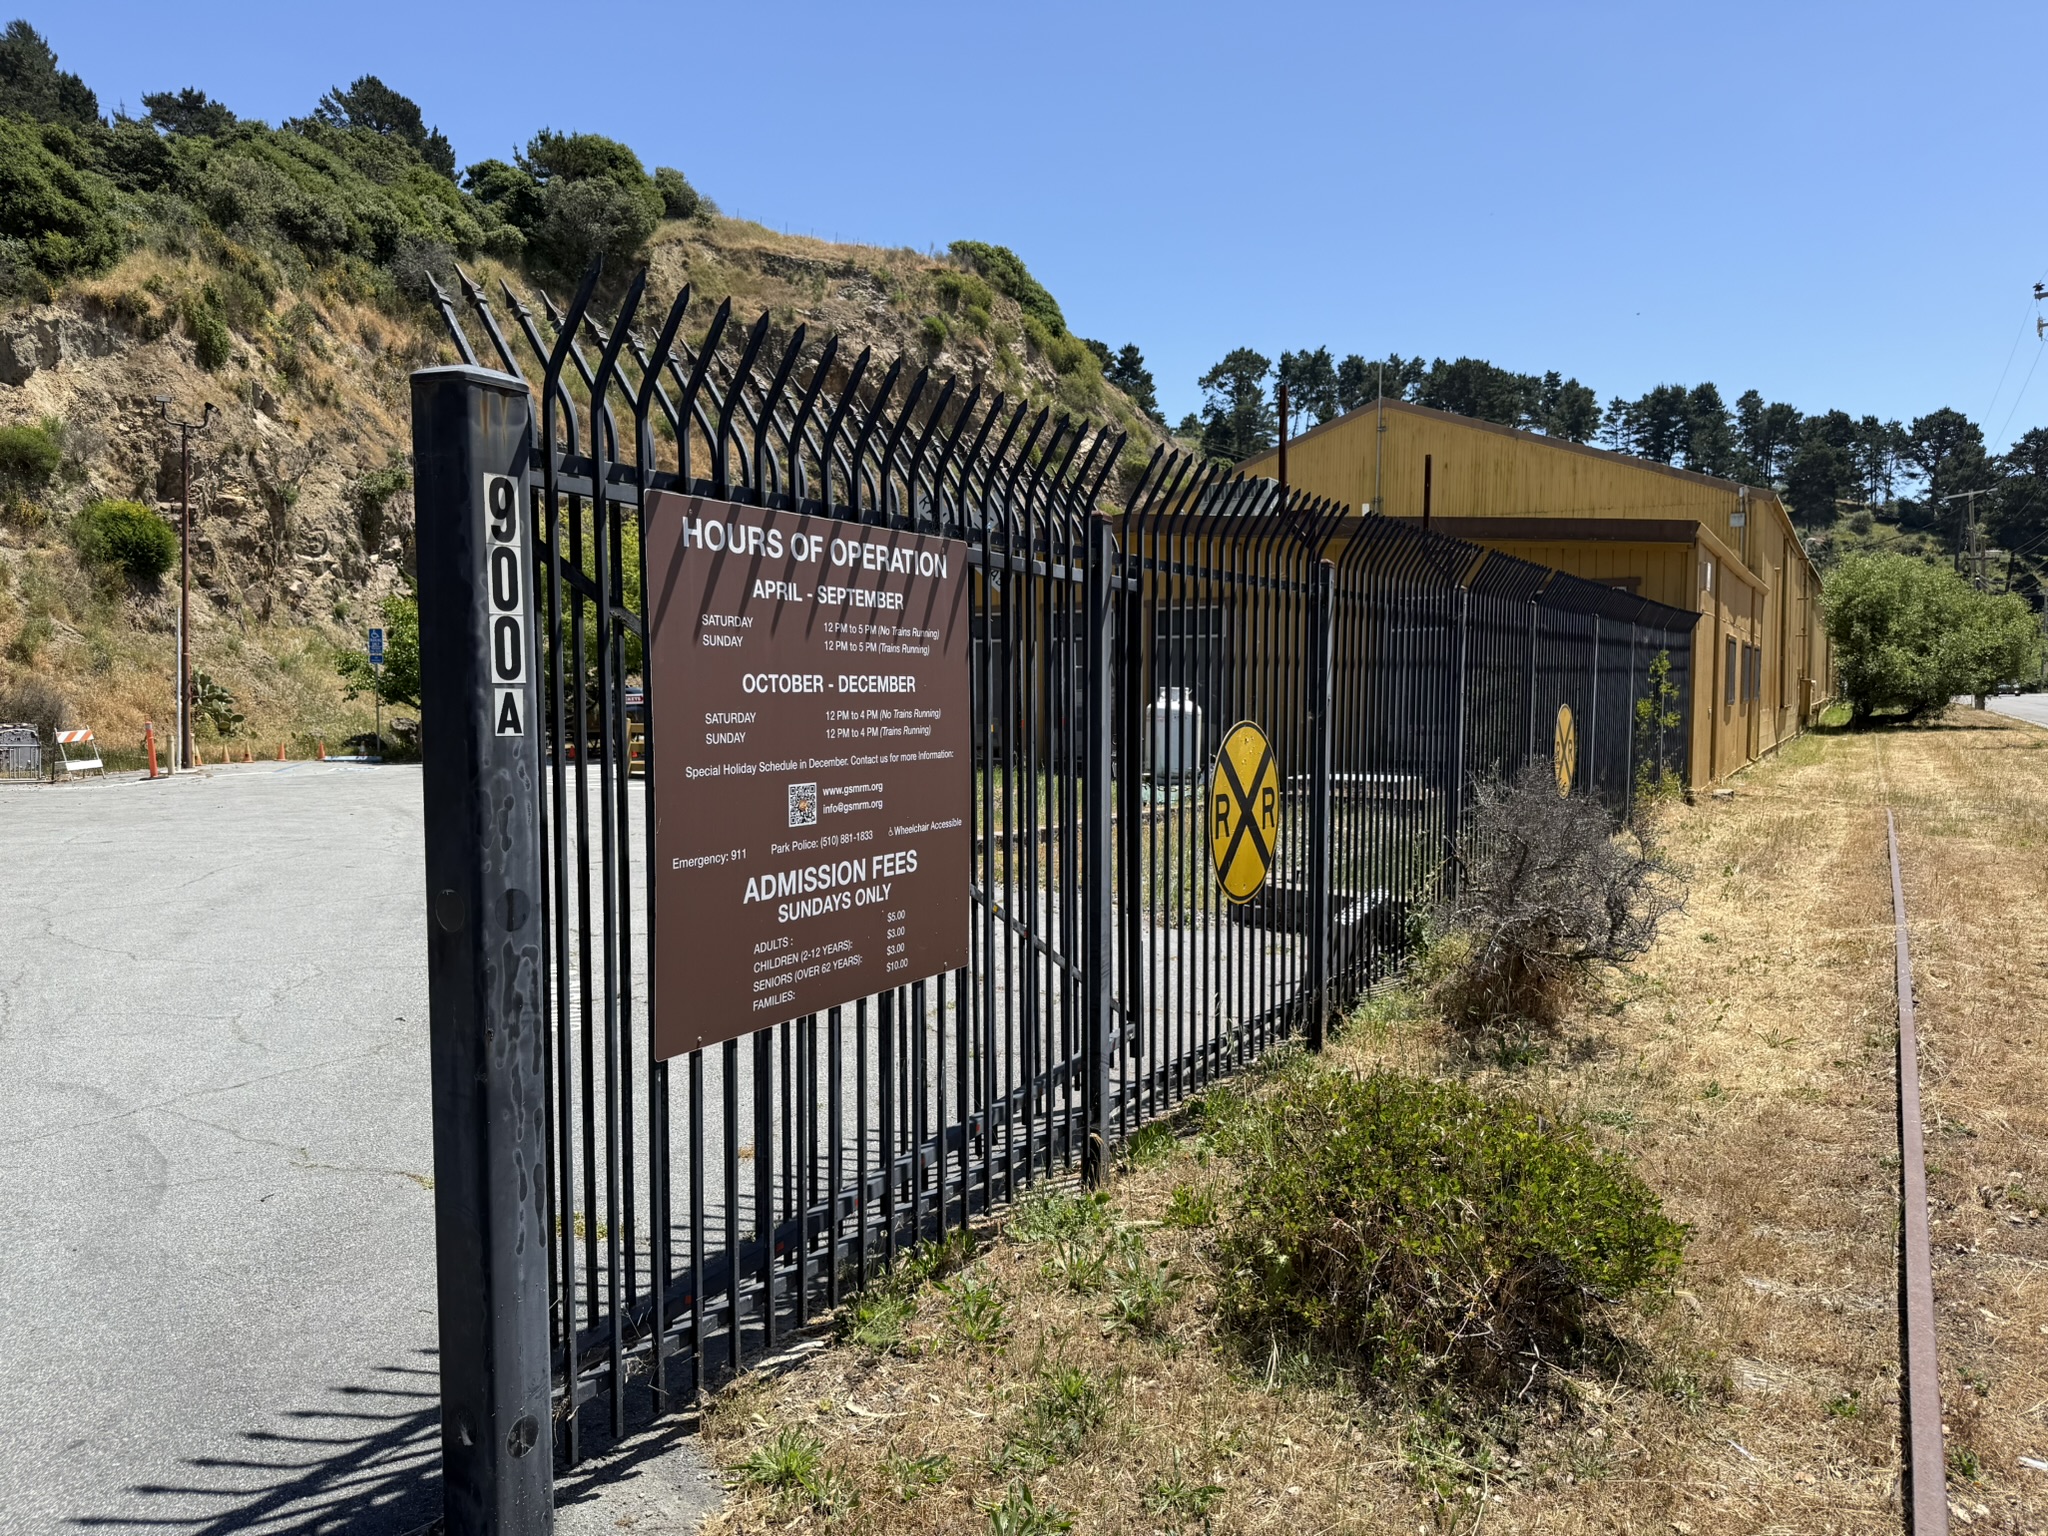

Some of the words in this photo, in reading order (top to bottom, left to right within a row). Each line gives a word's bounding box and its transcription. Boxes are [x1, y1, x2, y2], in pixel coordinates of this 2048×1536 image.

[683, 516, 783, 558] HOURS
[791, 533, 823, 562] OF
[831, 538, 947, 579] OPERATION
[753, 579, 802, 601] APRIL
[818, 586, 903, 609] SEPTEMBER
[702, 614, 753, 627] SATURDAY
[824, 622, 833, 632] 12
[835, 623, 847, 633] PM
[849, 624, 857, 633] to
[859, 624, 863, 634] 5
[865, 625, 876, 634] PM
[878, 625, 890, 637] (No
[892, 626, 910, 636] Trains
[912, 628, 939, 640] Running)
[703, 634, 743, 646] SUNDAY
[824, 641, 834, 650] 12
[836, 641, 848, 651] PM
[850, 642, 857, 651] to
[859, 642, 863, 652] 5
[866, 642, 877, 652] PM
[879, 643, 900, 654] (Trains
[902, 644, 929, 656] Running)
[743, 674, 823, 693] OCTOBER
[839, 675, 915, 692] DECEMBER
[705, 712, 756, 724] SATURDAY
[826, 711, 835, 720] 12
[837, 710, 849, 720] PM
[851, 711, 858, 720] to
[860, 710, 865, 719] 4
[867, 710, 878, 719] PM
[880, 710, 891, 720] (No
[894, 709, 912, 718] Trains
[914, 708, 941, 719] Running)
[706, 732, 745, 744] SUNDAY
[826, 729, 835, 738] 12
[837, 728, 849, 738] PM
[851, 728, 859, 737] to
[860, 728, 865, 737] 4
[867, 727, 878, 736] PM
[880, 727, 901, 738] (Trains
[903, 725, 931, 736] Running)
[686, 765, 720, 779] Special
[723, 763, 757, 775] Holiday
[759, 760, 797, 772] Schedule
[800, 759, 807, 769] in
[809, 757, 848, 768] December.
[851, 755, 878, 765] Contact
[890, 753, 899, 762] for
[823, 783, 883, 796] www.gsmrm.org
[823, 800, 883, 814] info@gsmrm.org
[1262, 786, 1275, 829] R
[1215, 793, 1230, 839] R
[894, 823, 929, 835] Wheelchair
[931, 818, 962, 830] Accessible
[771, 843, 790, 854] Park
[792, 840, 818, 851] Police:
[820, 835, 838, 849] (510)
[840, 830, 873, 844] 881-1833
[673, 854, 728, 869] Emergency:
[731, 849, 746, 860] 911
[743, 858, 866, 904] ADMISSION
[873, 850, 917, 879] FEES
[778, 891, 851, 923] SUNDAYS
[855, 883, 891, 906] ONLY
[887, 910, 905, 922] $5.00
[887, 926, 905, 939] $3.00
[753, 954, 799, 973] CHILDREN
[800, 948, 820, 964] (2-12
[822, 940, 852, 957] YEARS):
[887, 943, 904, 956] $3.00
[753, 972, 793, 992] SENIORS
[794, 966, 820, 983] (OVER
[821, 962, 831, 973] 62
[832, 954, 862, 972] YEARS):
[887, 958, 908, 972] $10.00
[753, 991, 795, 1011] FAMILIES:
